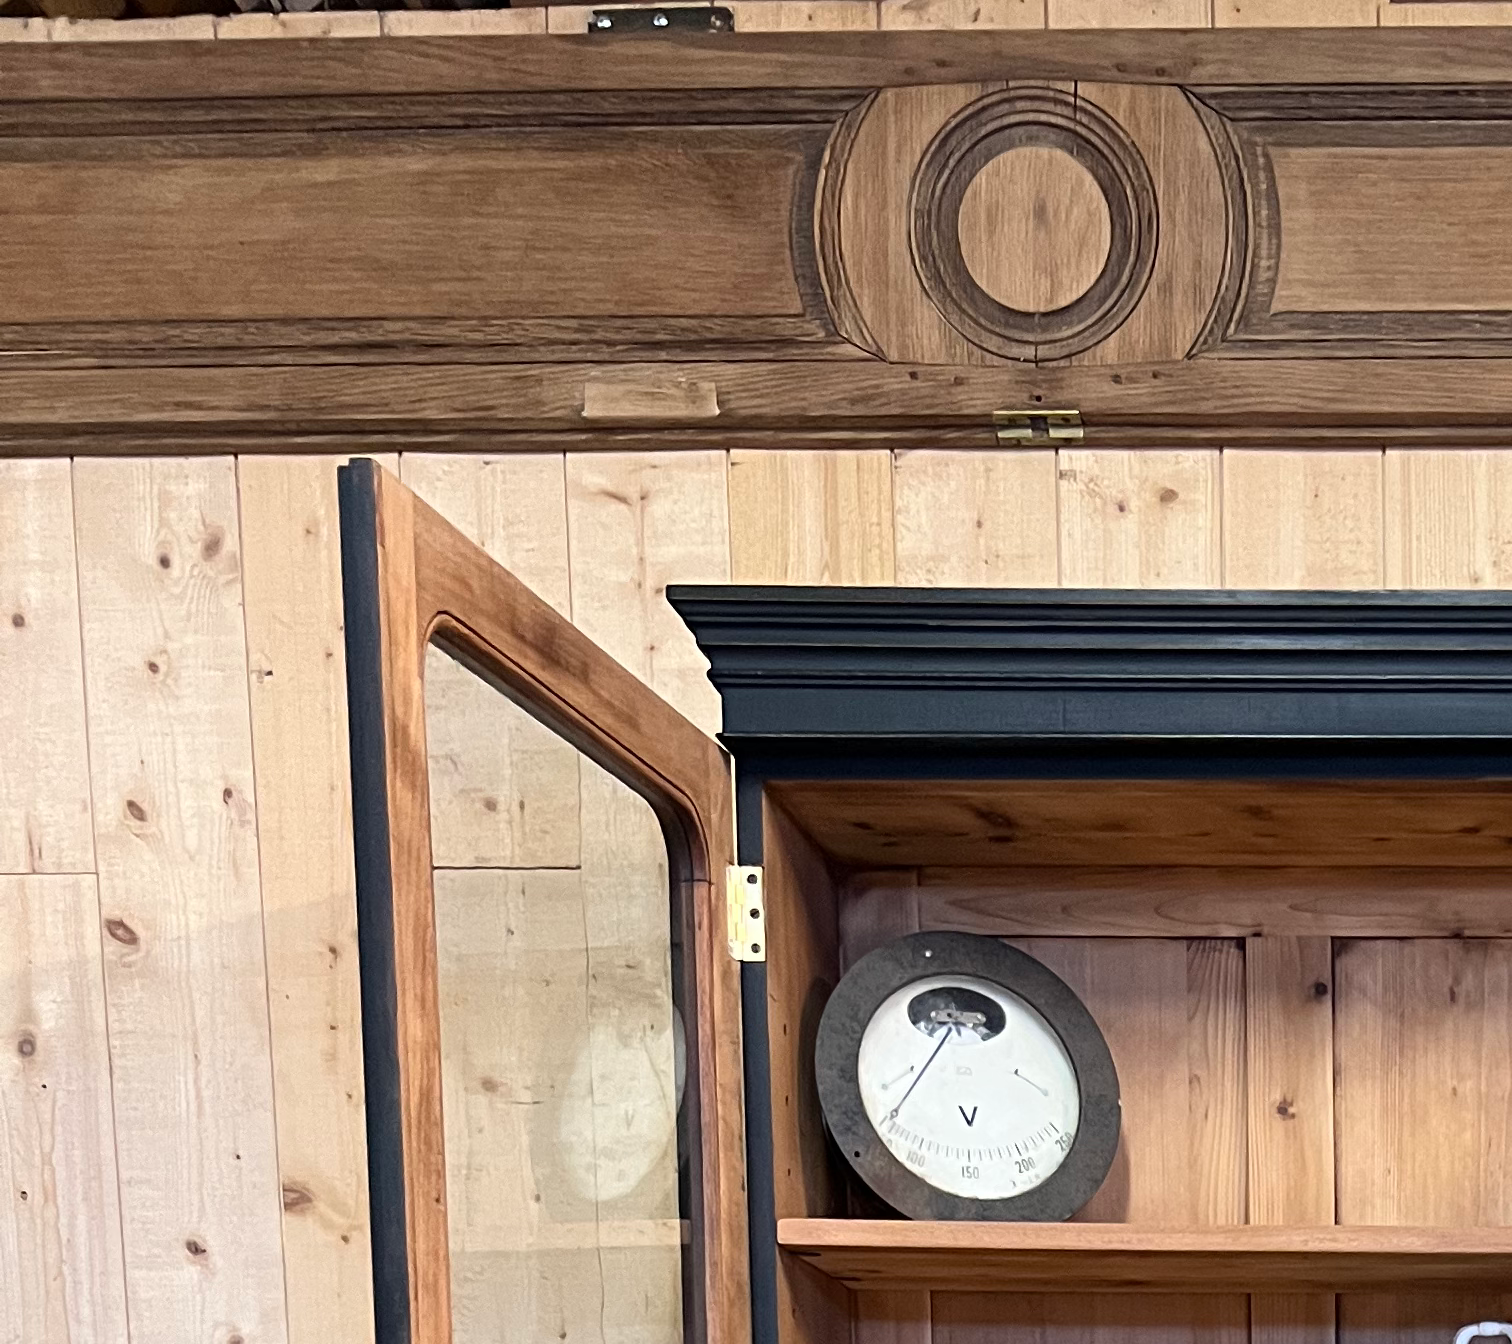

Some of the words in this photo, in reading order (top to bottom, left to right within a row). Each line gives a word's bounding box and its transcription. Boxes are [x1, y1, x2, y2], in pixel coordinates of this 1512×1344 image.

[957, 1105, 978, 1127] V
[905, 1151, 926, 1169] 100
[961, 1166, 981, 1180] 150
[1014, 1156, 1037, 1174] 200
